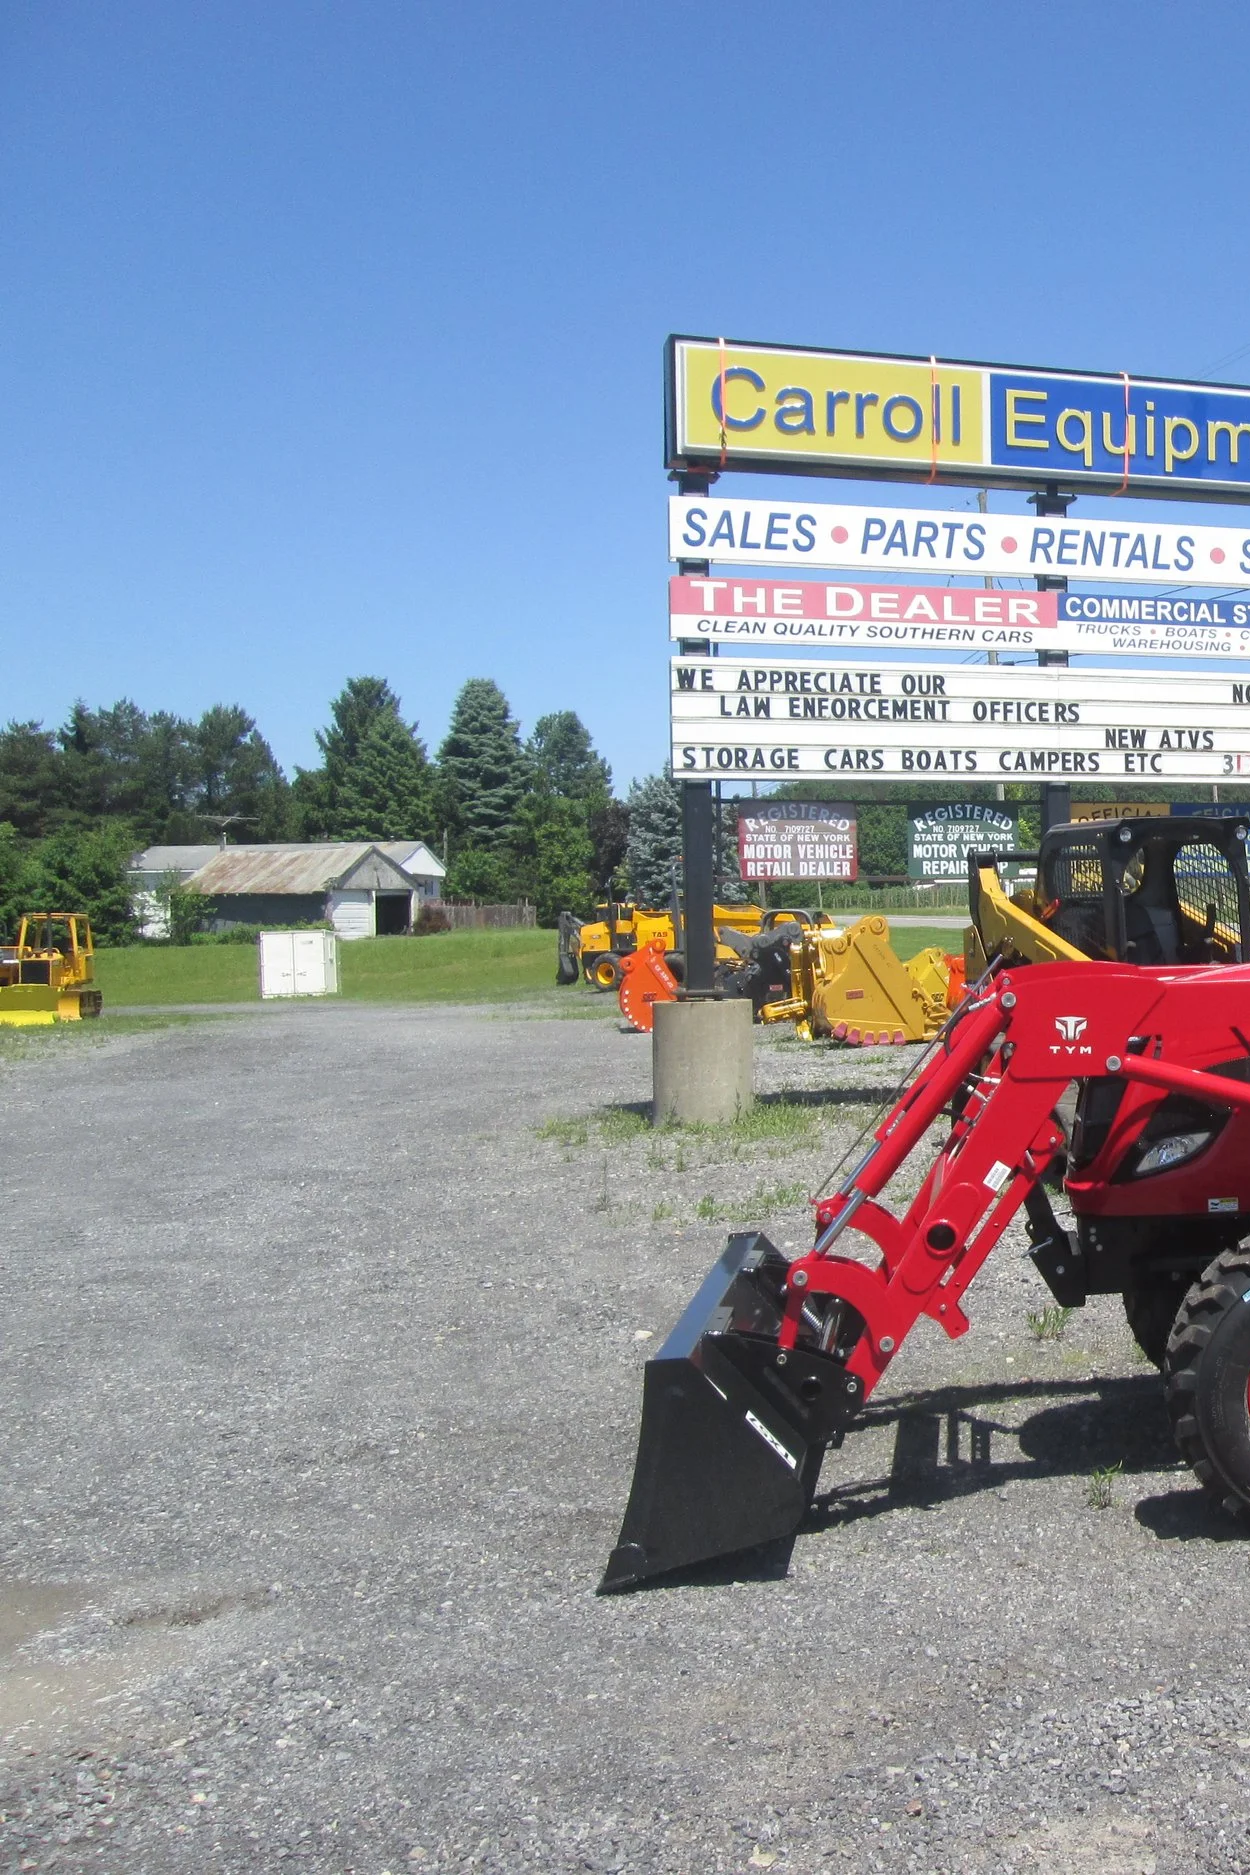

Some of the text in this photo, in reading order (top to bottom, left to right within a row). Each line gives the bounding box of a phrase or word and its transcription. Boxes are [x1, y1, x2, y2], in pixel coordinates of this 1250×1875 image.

[711, 366, 961, 445] Carroll
[682, 508, 816, 552] SALES
[860, 518, 986, 560] PARTS
[1029, 527, 1195, 571] RENTALS
[690, 580, 1040, 624] THE DEALER
[1065, 597, 1226, 624] COMMERCIAL
[697, 619, 1033, 644] CLEAN QUALITY SOUTHERN CARS
[1076, 623, 1142, 636] TRUCKS
[1165, 627, 1217, 639] BOATS
[1113, 638, 1232, 652] WAREHOUSING
[676, 668, 946, 695] WE APPRECIATE OUR
[720, 695, 1080, 723] LAW ENFORCEMENT OFFICERS
[1105, 729, 1214, 750] NEW ATVS
[682, 747, 1162, 773] STORAGE CARS BOATS CAMPERS ETC
[745, 804, 850, 832] REGISTERED
[913, 804, 1013, 832] REGISTERED
[745, 834, 851, 842] STATE OF NEW YORK
[947, 825, 979, 833] 7109727
[947, 833, 960, 841] OF
[963, 833, 984, 841] NEW
[987, 833, 1013, 841] YORK
[743, 844, 853, 859] MOTOR VEHICLE
[913, 844, 957, 858] MOTOR
[747, 861, 851, 877] RETAIL DEALER
[923, 861, 969, 875] REPAIR
[1049, 1046, 1092, 1055] TYM
